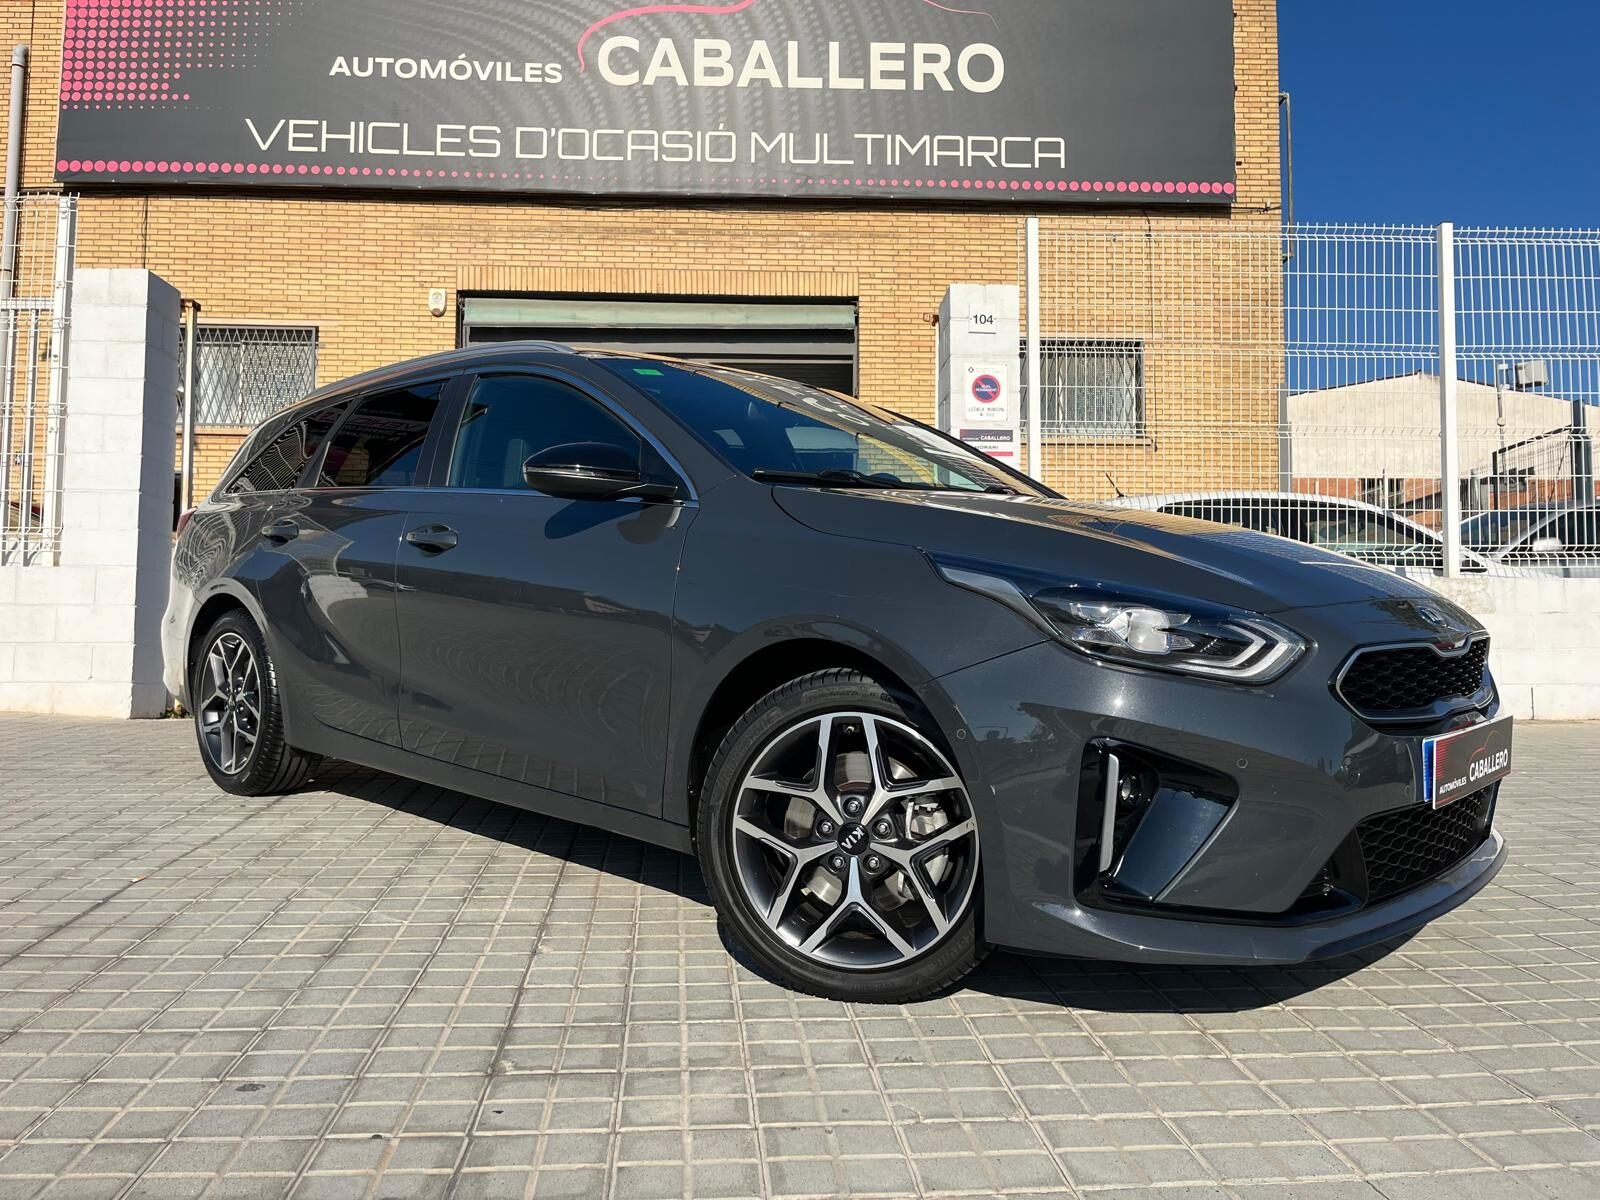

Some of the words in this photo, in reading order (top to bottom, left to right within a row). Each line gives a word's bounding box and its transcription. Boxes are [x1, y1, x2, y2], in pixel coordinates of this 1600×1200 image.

[329, 53, 563, 84] AUTOMÓVILES
[598, 35, 1005, 93] CABALLERO
[245, 118, 501, 158] VEHICLES
[515, 123, 737, 163] D'OCASIÓ
[750, 131, 1066, 169] MULTIMARCA
[972, 314, 994, 325] 104
[1439, 777, 1467, 794] AUTOMÓVILES
[1469, 748, 1508, 782] CABALLERO
[841, 826, 864, 849] KIA
